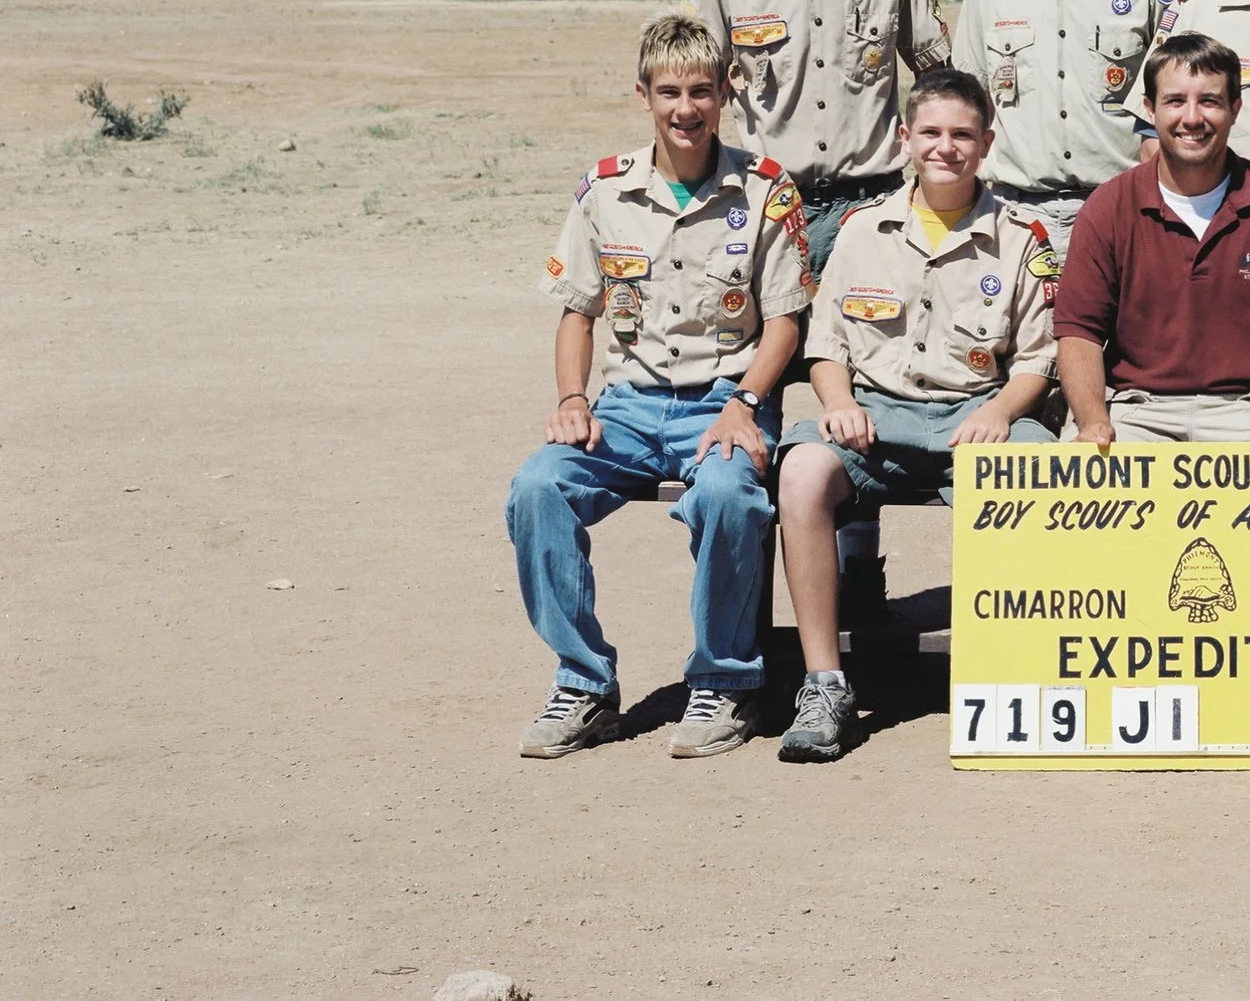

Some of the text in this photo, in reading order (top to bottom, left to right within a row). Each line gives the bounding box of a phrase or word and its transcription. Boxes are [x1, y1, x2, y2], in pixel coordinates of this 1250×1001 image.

[975, 454, 1156, 490] PHILMONT
[973, 500, 1036, 531] BOY
[1044, 499, 1156, 531] SCOUTS
[1176, 500, 1218, 531] OF
[974, 588, 1126, 620] CIMARRON
[964, 698, 1077, 743] 719
